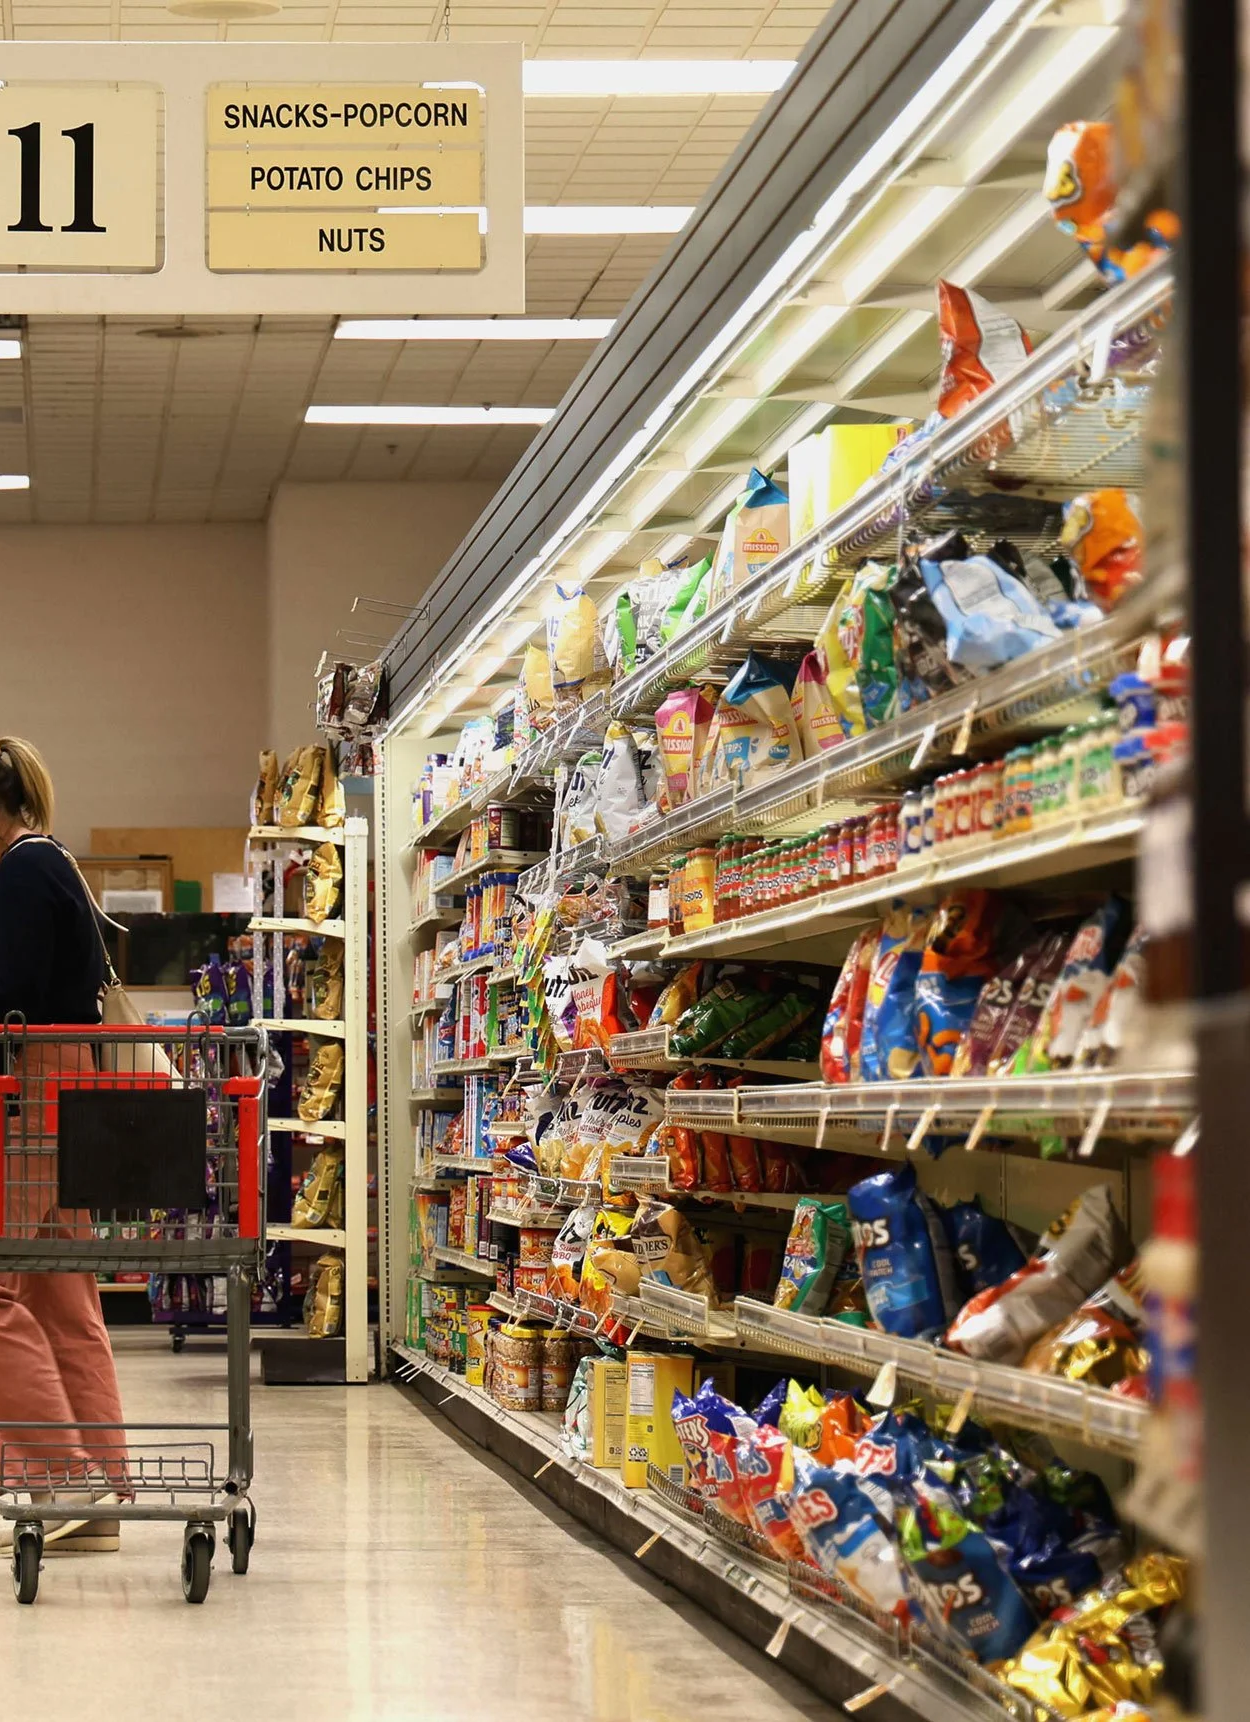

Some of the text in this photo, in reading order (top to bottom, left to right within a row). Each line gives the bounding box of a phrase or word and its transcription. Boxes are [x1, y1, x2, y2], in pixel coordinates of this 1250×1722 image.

[224, 102, 468, 129] SNACKS-POPCORN
[7, 121, 107, 233] 11
[250, 166, 432, 191] POTATO CHIPS
[318, 227, 386, 253] NUTS
